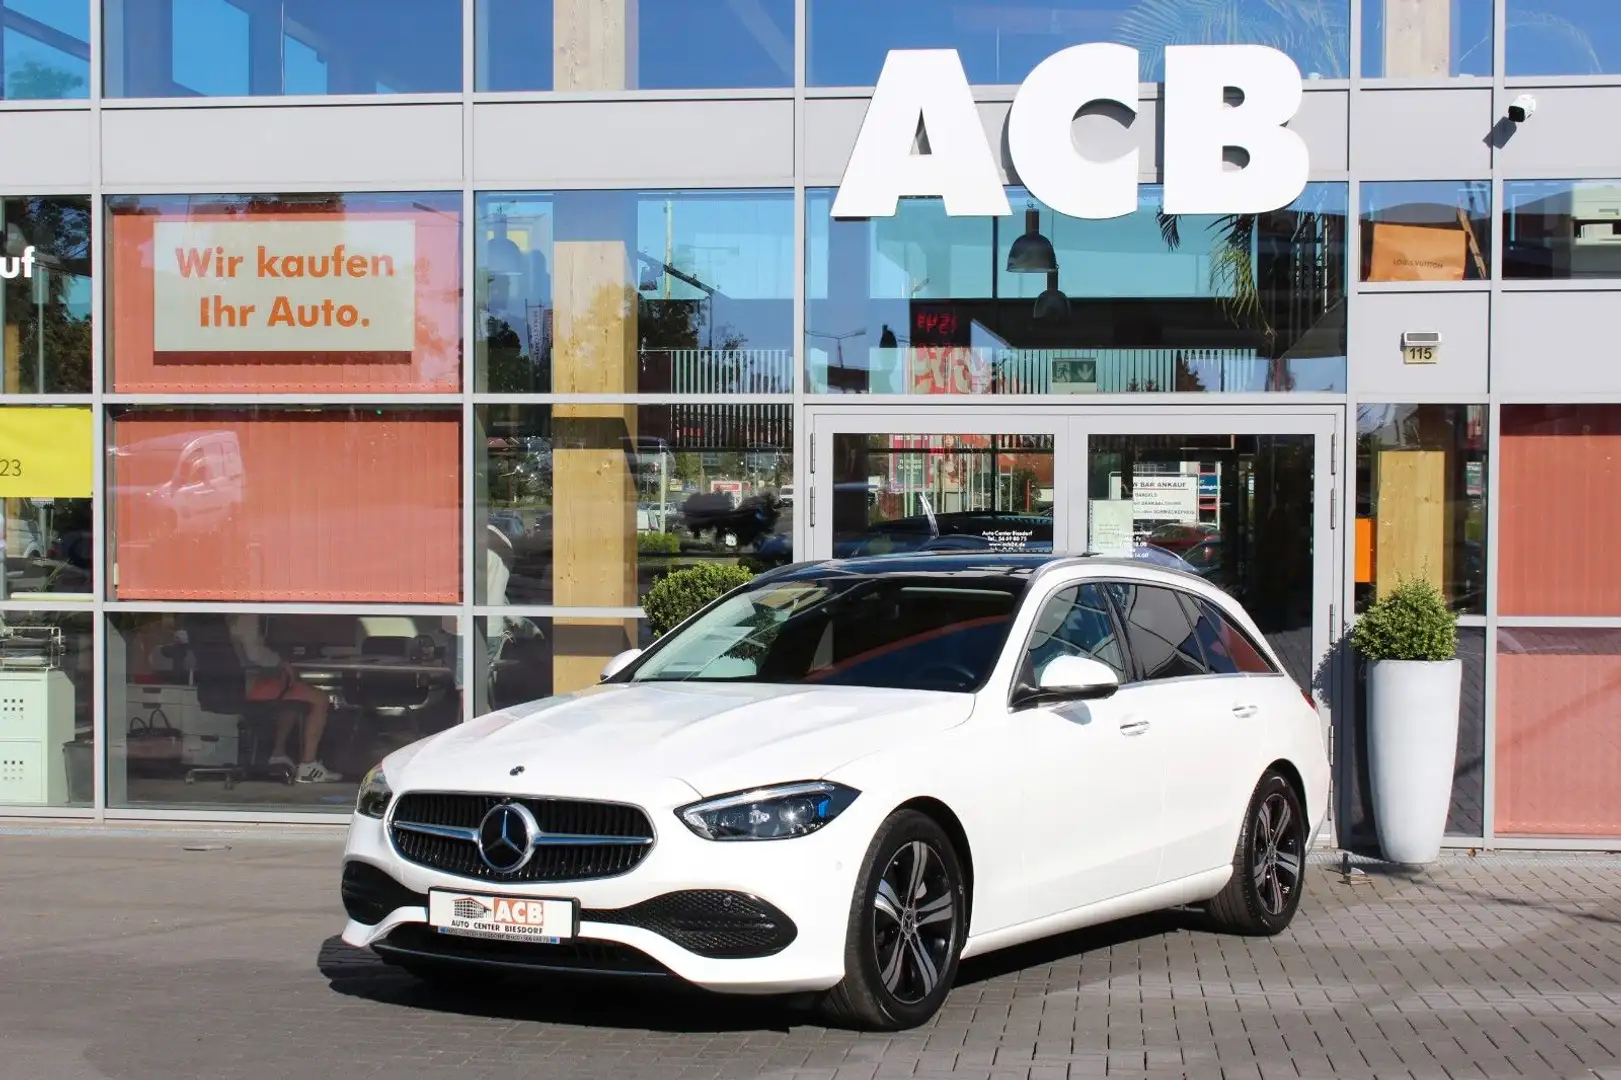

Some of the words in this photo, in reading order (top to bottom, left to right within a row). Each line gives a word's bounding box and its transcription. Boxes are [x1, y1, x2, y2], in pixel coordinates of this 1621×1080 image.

[830, 42, 1309, 218] ACB
[175, 246, 244, 278] Wir
[257, 244, 394, 278] kaufen
[200, 295, 256, 327] Ihr
[267, 296, 370, 328] Auto.
[1409, 347, 1432, 360] 115
[451, 919, 470, 928] AUTO
[473, 922, 500, 932] CENTER
[504, 925, 543, 934] BIESDORF
[494, 899, 543, 926] ACB
